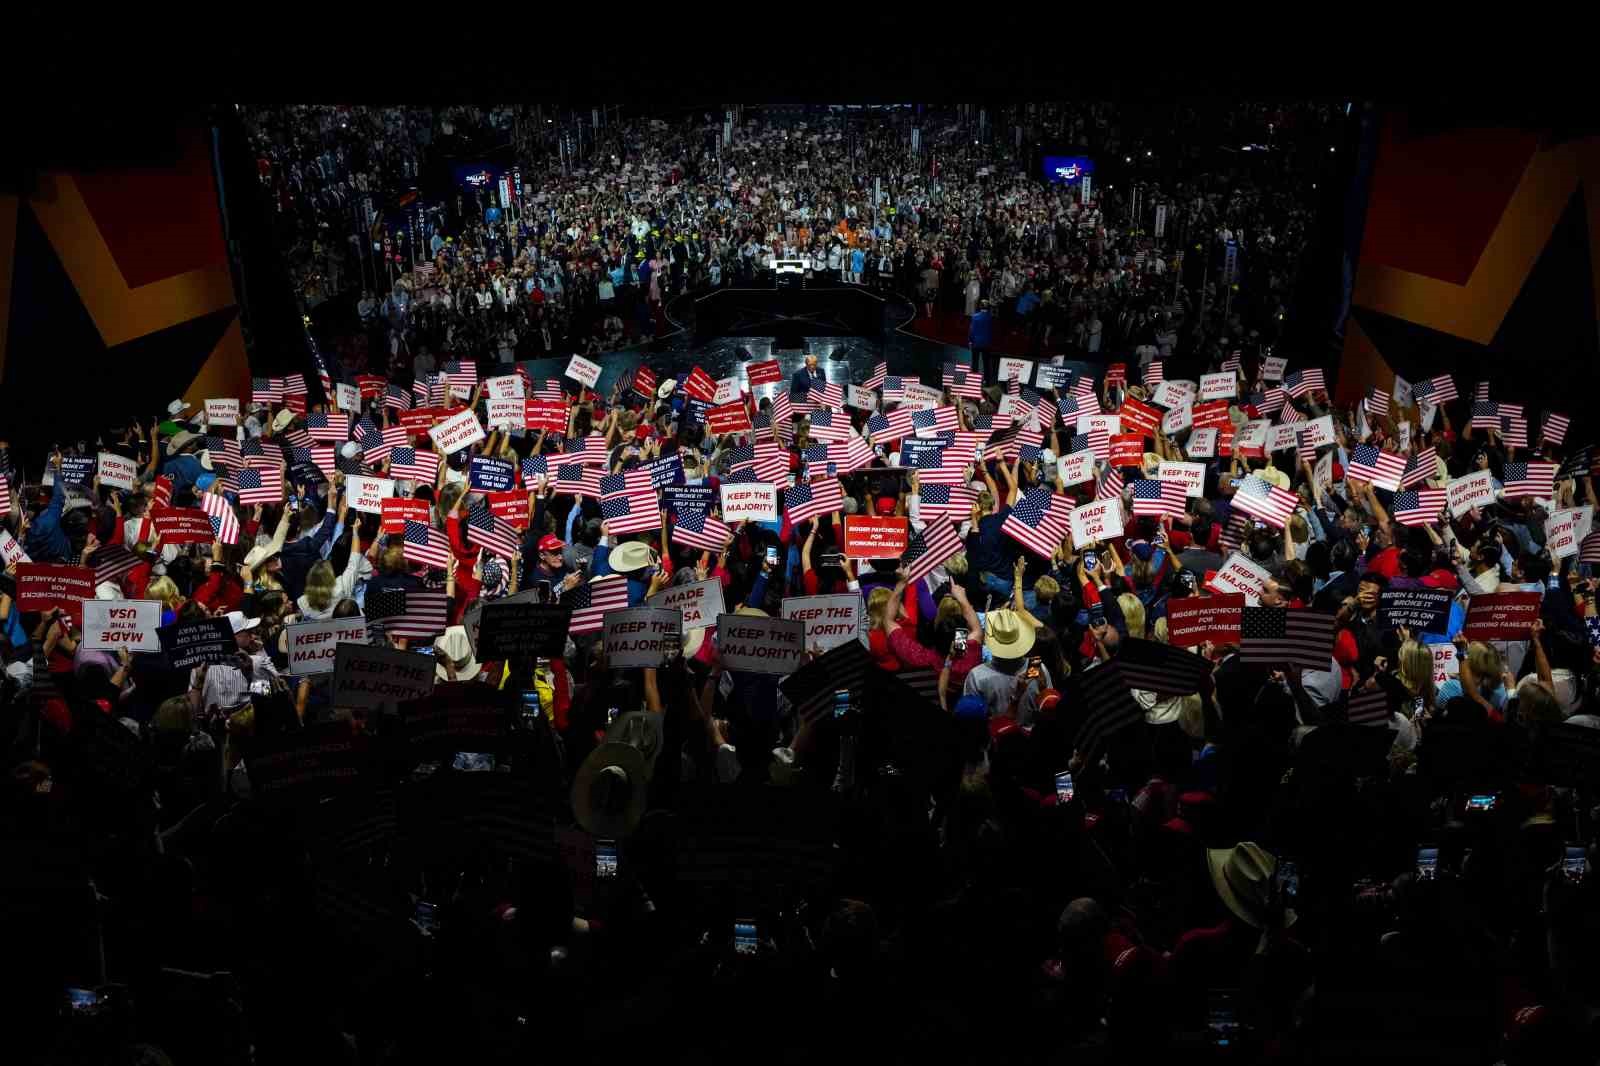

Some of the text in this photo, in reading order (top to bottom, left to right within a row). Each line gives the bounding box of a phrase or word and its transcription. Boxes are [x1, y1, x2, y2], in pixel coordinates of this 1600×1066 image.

[436, 417, 474, 440] MAJORITY
[1090, 419, 1106, 427] USA
[458, 427, 478, 440] KEEP
[103, 460, 122, 470] KEEP
[659, 454, 679, 466] HARRIS
[1064, 456, 1084, 467] MADE
[666, 470, 676, 479] ON
[1068, 472, 1082, 480] USA
[1184, 470, 1200, 478] THE
[362, 482, 380, 491] USA
[1450, 478, 1487, 497] KEEP THE
[728, 492, 772, 500] KEEP THE
[1452, 488, 1490, 507] MAJORITY
[726, 503, 774, 512] MAJORITY
[1080, 506, 1106, 521] MADE
[1085, 524, 1104, 536] USA
[1230, 563, 1256, 580] KEEP
[664, 588, 704, 605] MADE
[1415, 593, 1449, 602] HARRIS
[110, 609, 136, 619] USA
[684, 610, 702, 622] SA
[790, 607, 852, 620] KEEP THE
[1171, 607, 1242, 619] BIGGER PAYCHECKS
[610, 622, 676, 634] KEEP THE
[1408, 618, 1430, 626] WAY
[727, 627, 798, 642] KEEP THE
[807, 622, 856, 636] JORITY
[1173, 626, 1207, 636] WORKING
[102, 632, 144, 642] MADE
[176, 635, 192, 644] ON
[295, 628, 364, 645] KEEP THE
[294, 648, 336, 662] MAJO
[723, 644, 800, 660] MAJORITY
[1434, 650, 1453, 660] DE
[345, 658, 425, 682] KEEP THE
[338, 679, 427, 698] MAJORITY
